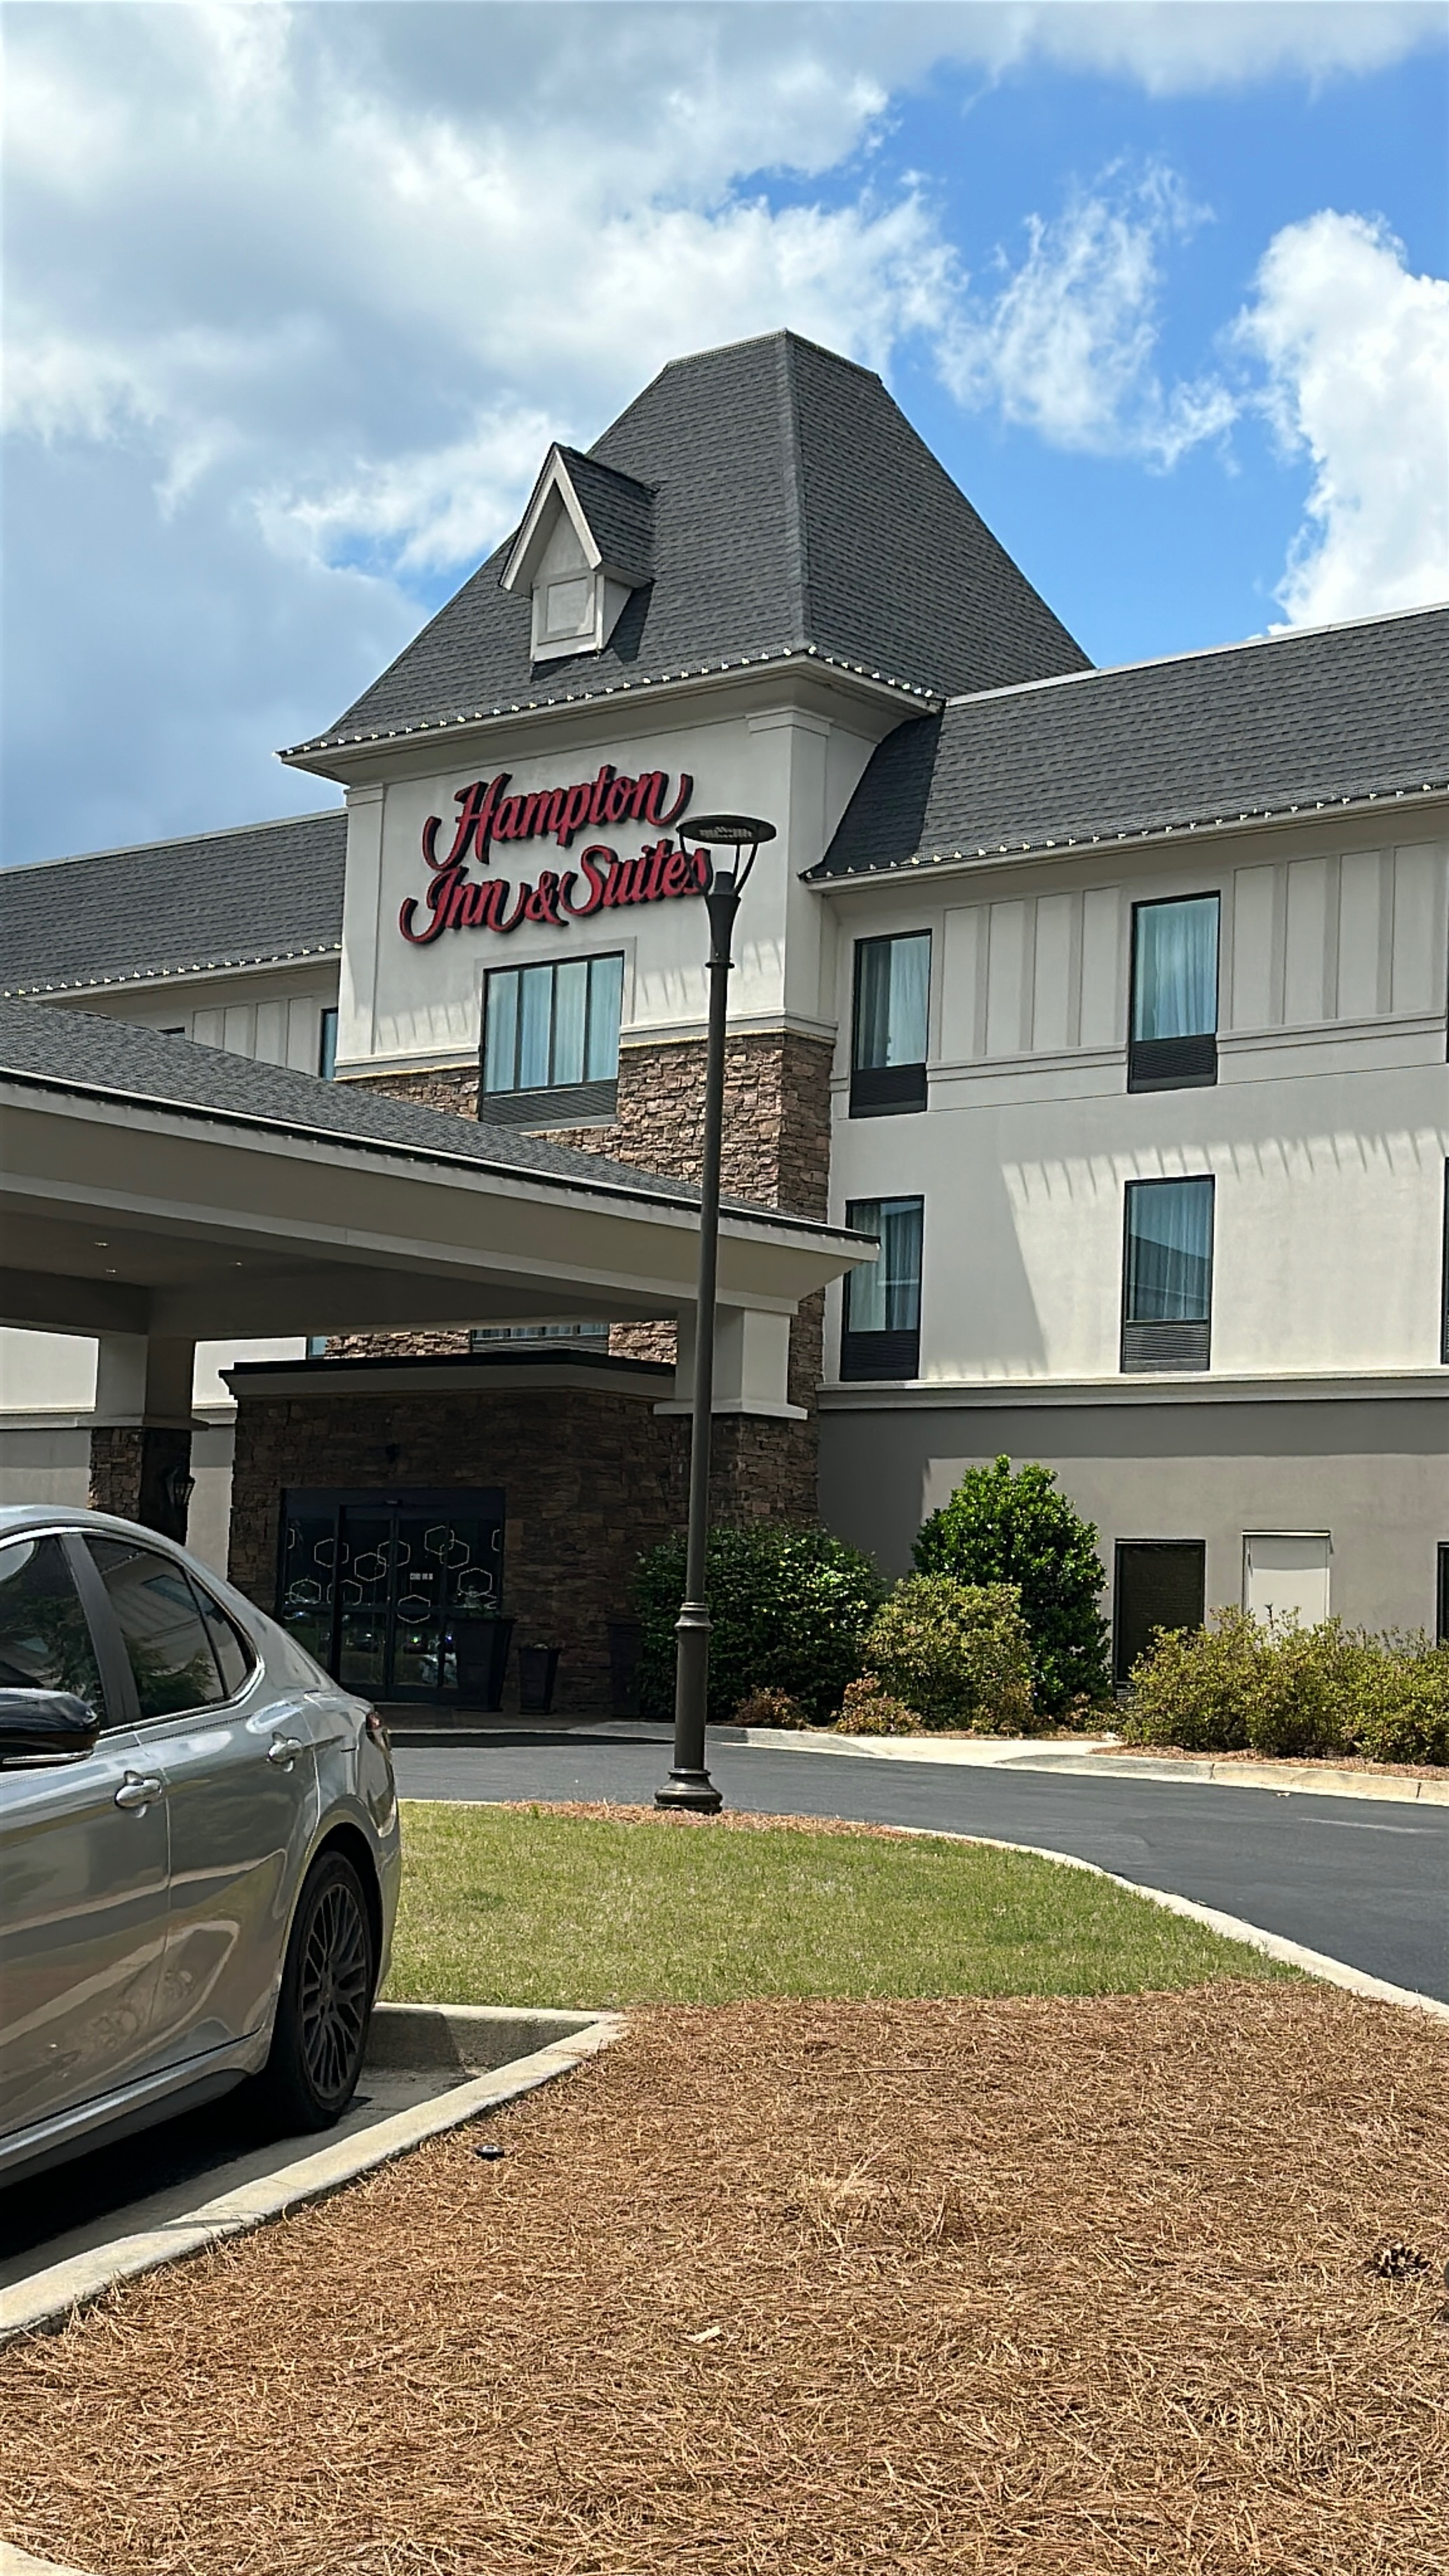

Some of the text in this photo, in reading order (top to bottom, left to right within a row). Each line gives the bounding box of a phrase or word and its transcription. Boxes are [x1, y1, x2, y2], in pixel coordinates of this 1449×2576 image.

[422, 764, 694, 871] Hampton
[400, 839, 714, 944] Inn & Suites
